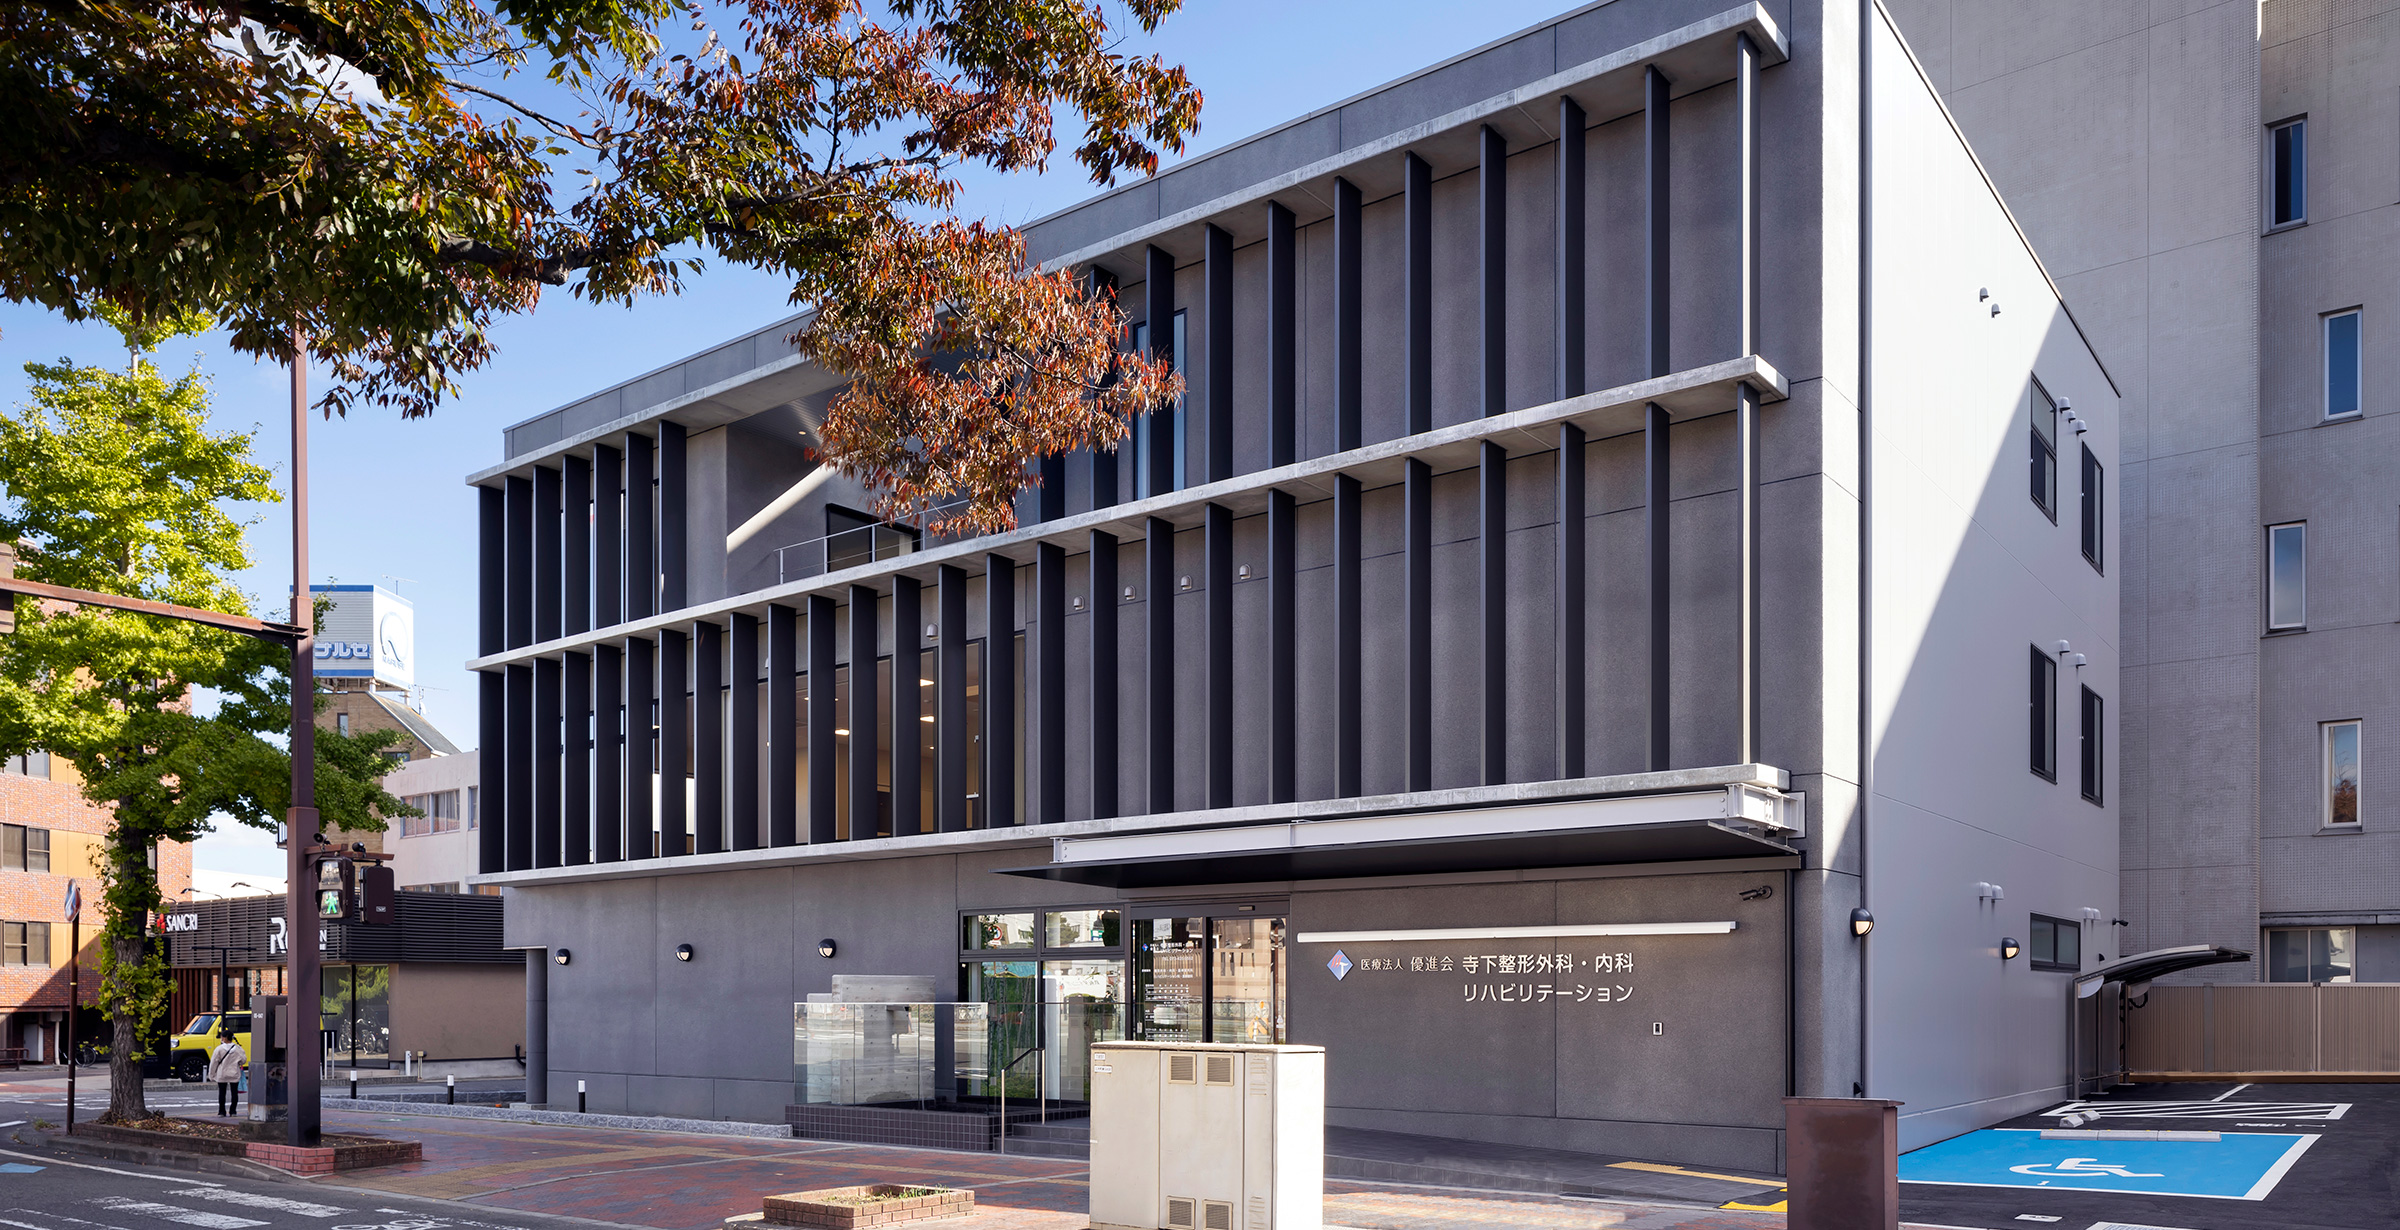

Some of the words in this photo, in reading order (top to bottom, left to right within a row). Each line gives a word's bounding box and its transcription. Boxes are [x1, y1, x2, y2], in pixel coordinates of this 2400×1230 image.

[1360, 958, 1404, 971] 医療法人
[1410, 955, 1455, 972] 優進会
[1462, 952, 1634, 974] 寺下整形外科・内科
[1463, 983, 1634, 1003] リハビリテーション
